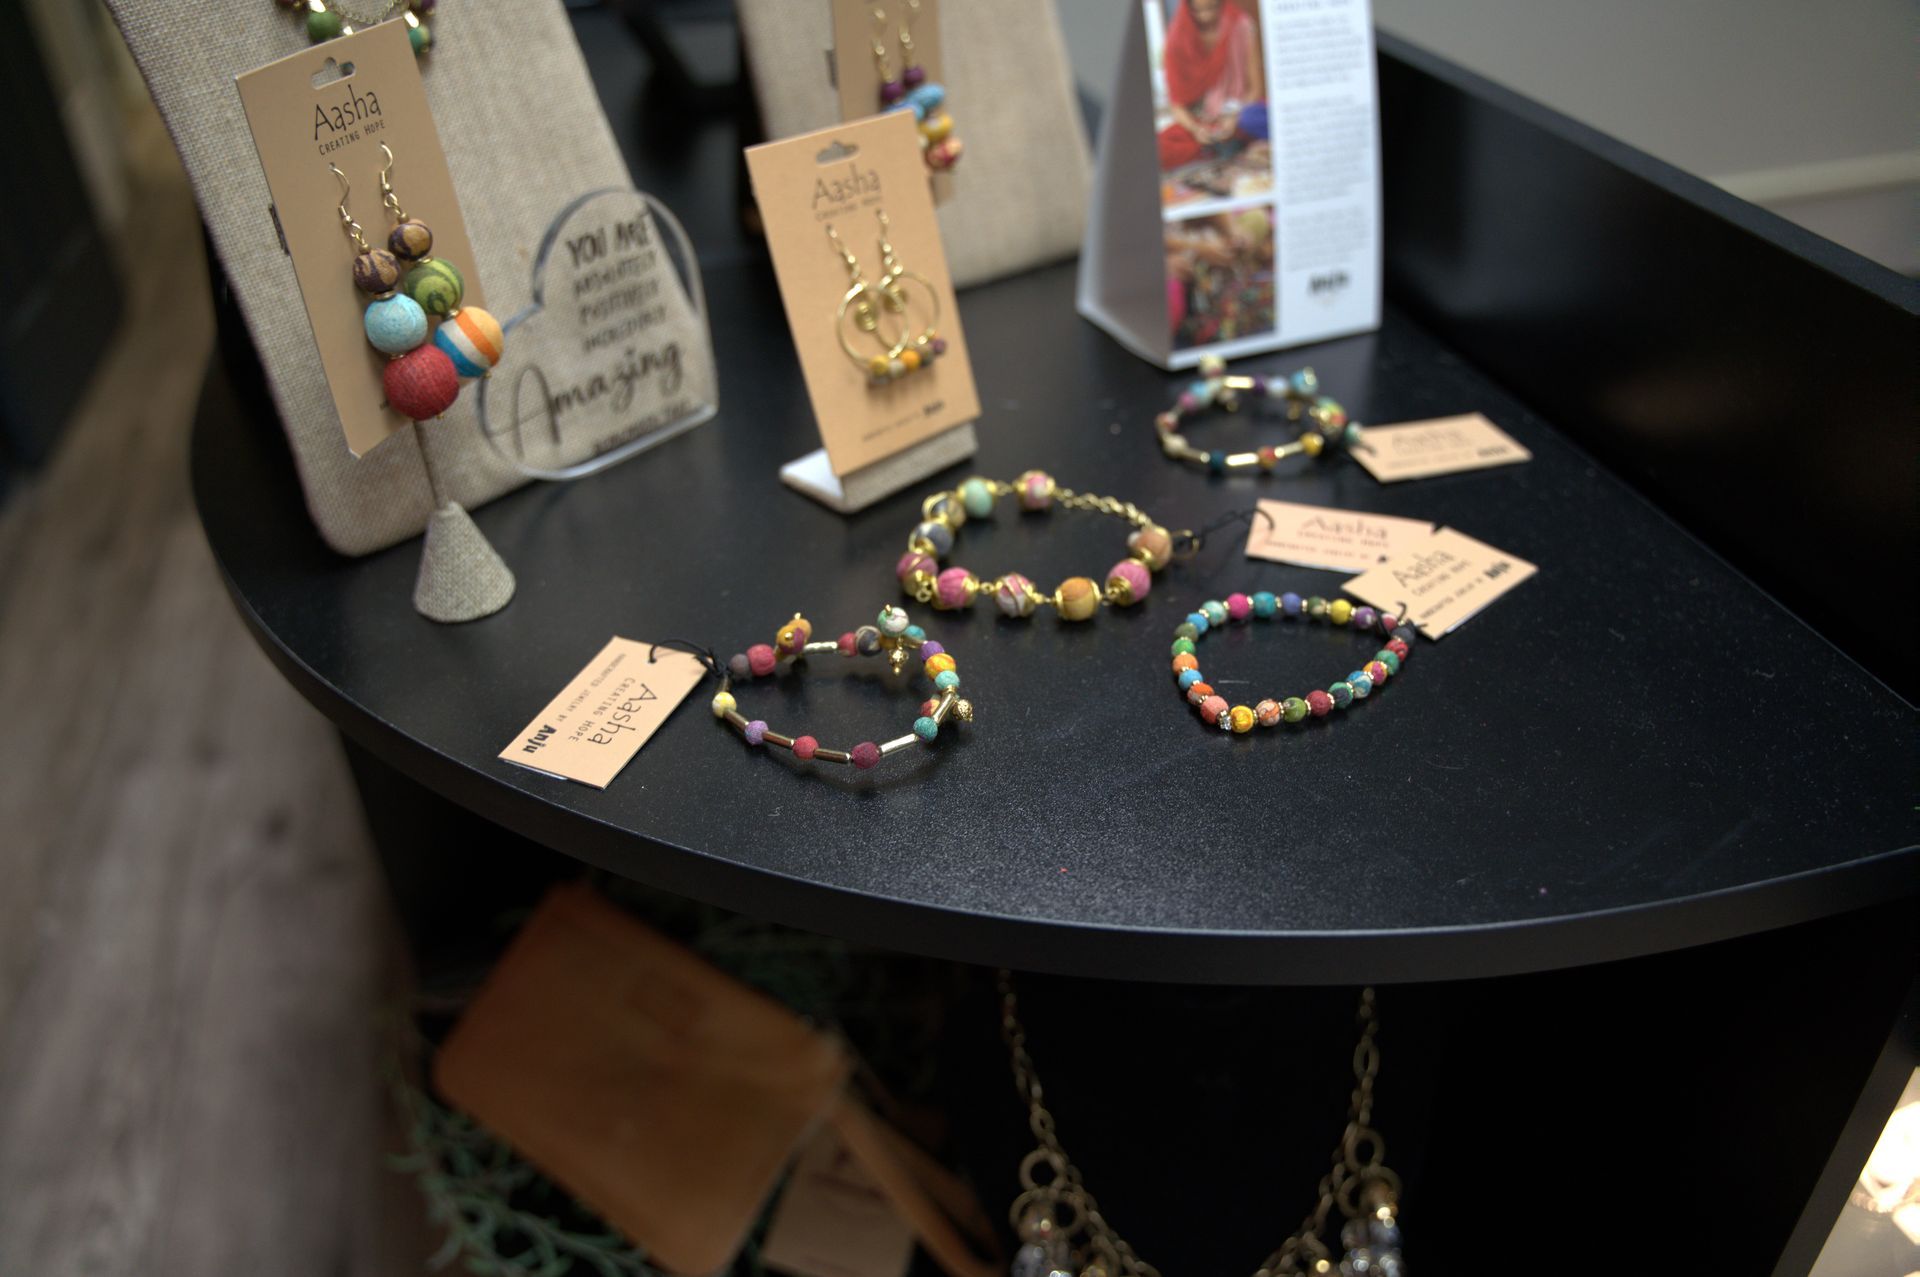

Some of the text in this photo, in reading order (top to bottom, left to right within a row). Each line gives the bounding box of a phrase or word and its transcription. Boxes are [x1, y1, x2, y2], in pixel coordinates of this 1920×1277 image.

[314, 84, 382, 141] Aasha
[319, 119, 386, 156] CREATING HOPE
[811, 161, 882, 211] Aasha
[565, 227, 607, 268] YOU
[505, 342, 684, 459] Amazing
[568, 677, 636, 742] CREATING HOPE
[587, 683, 658, 745] Aasha
[522, 723, 558, 754] Anju
